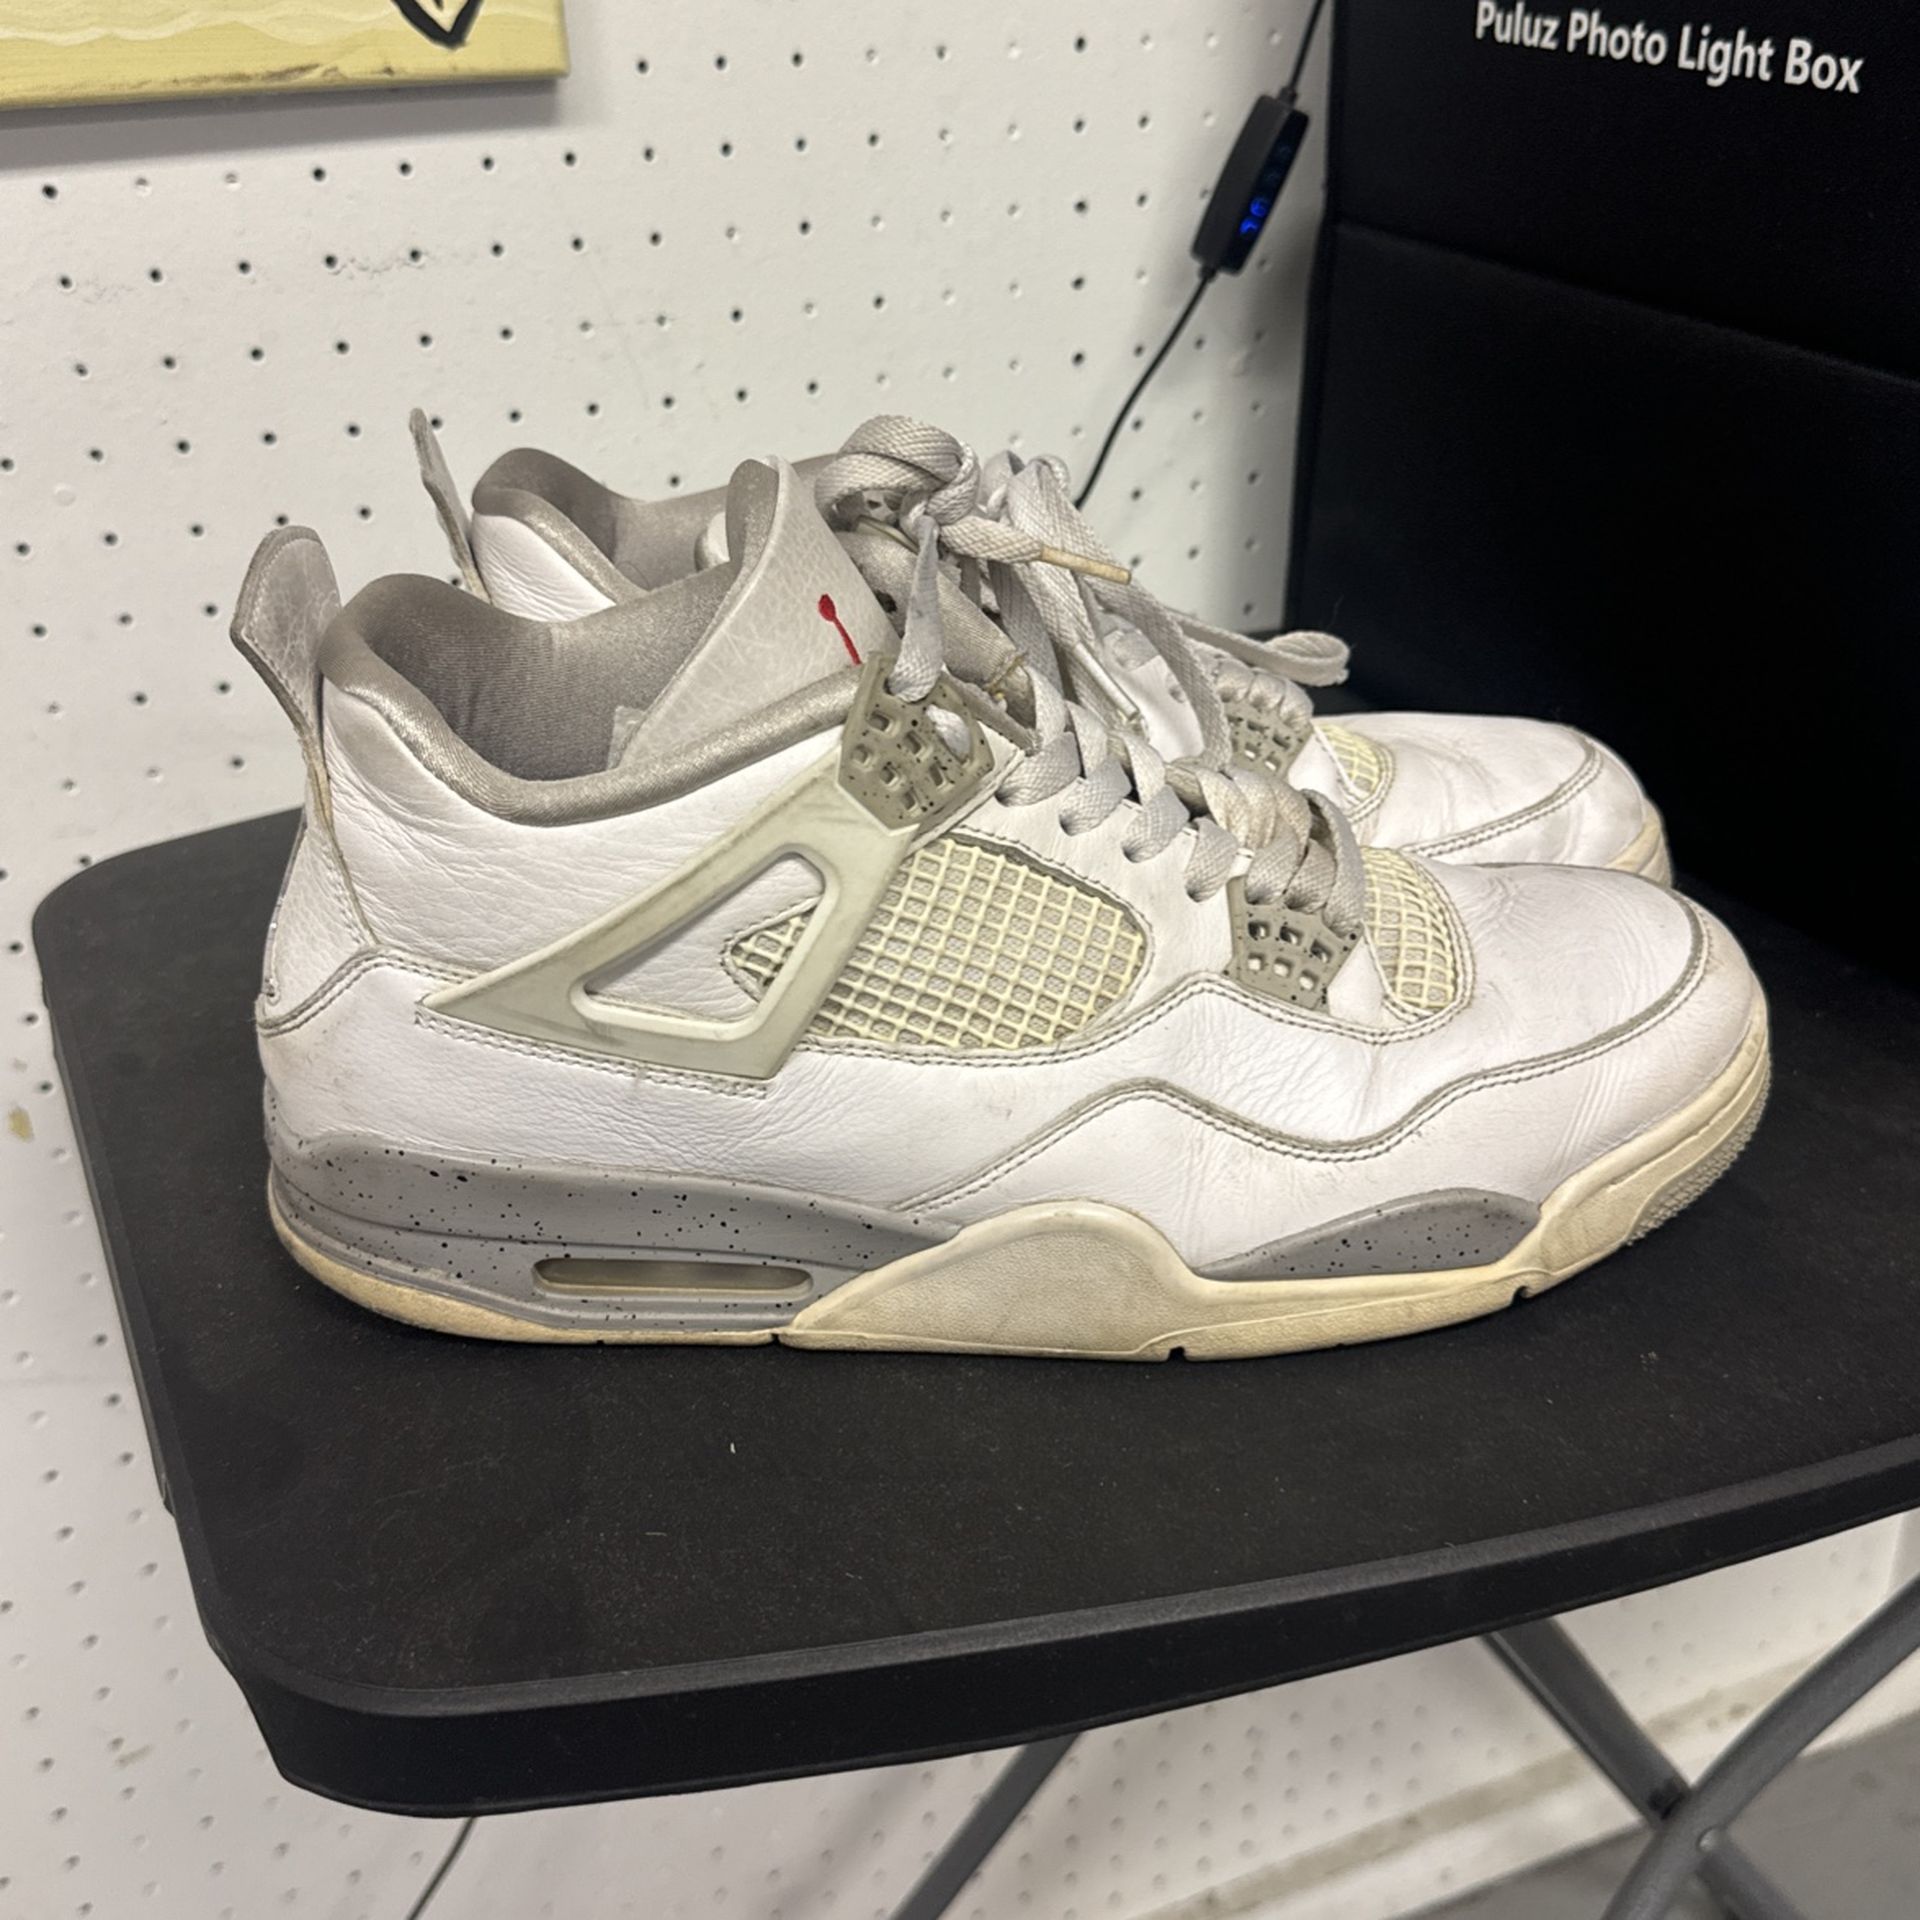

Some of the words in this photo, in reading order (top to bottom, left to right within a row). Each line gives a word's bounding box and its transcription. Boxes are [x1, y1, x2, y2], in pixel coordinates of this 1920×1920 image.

[1475, 0, 1560, 50] Puluz
[1566, 9, 1668, 65] Photo
[1677, 24, 1775, 87] Light
[1784, 38, 1864, 94] Box
